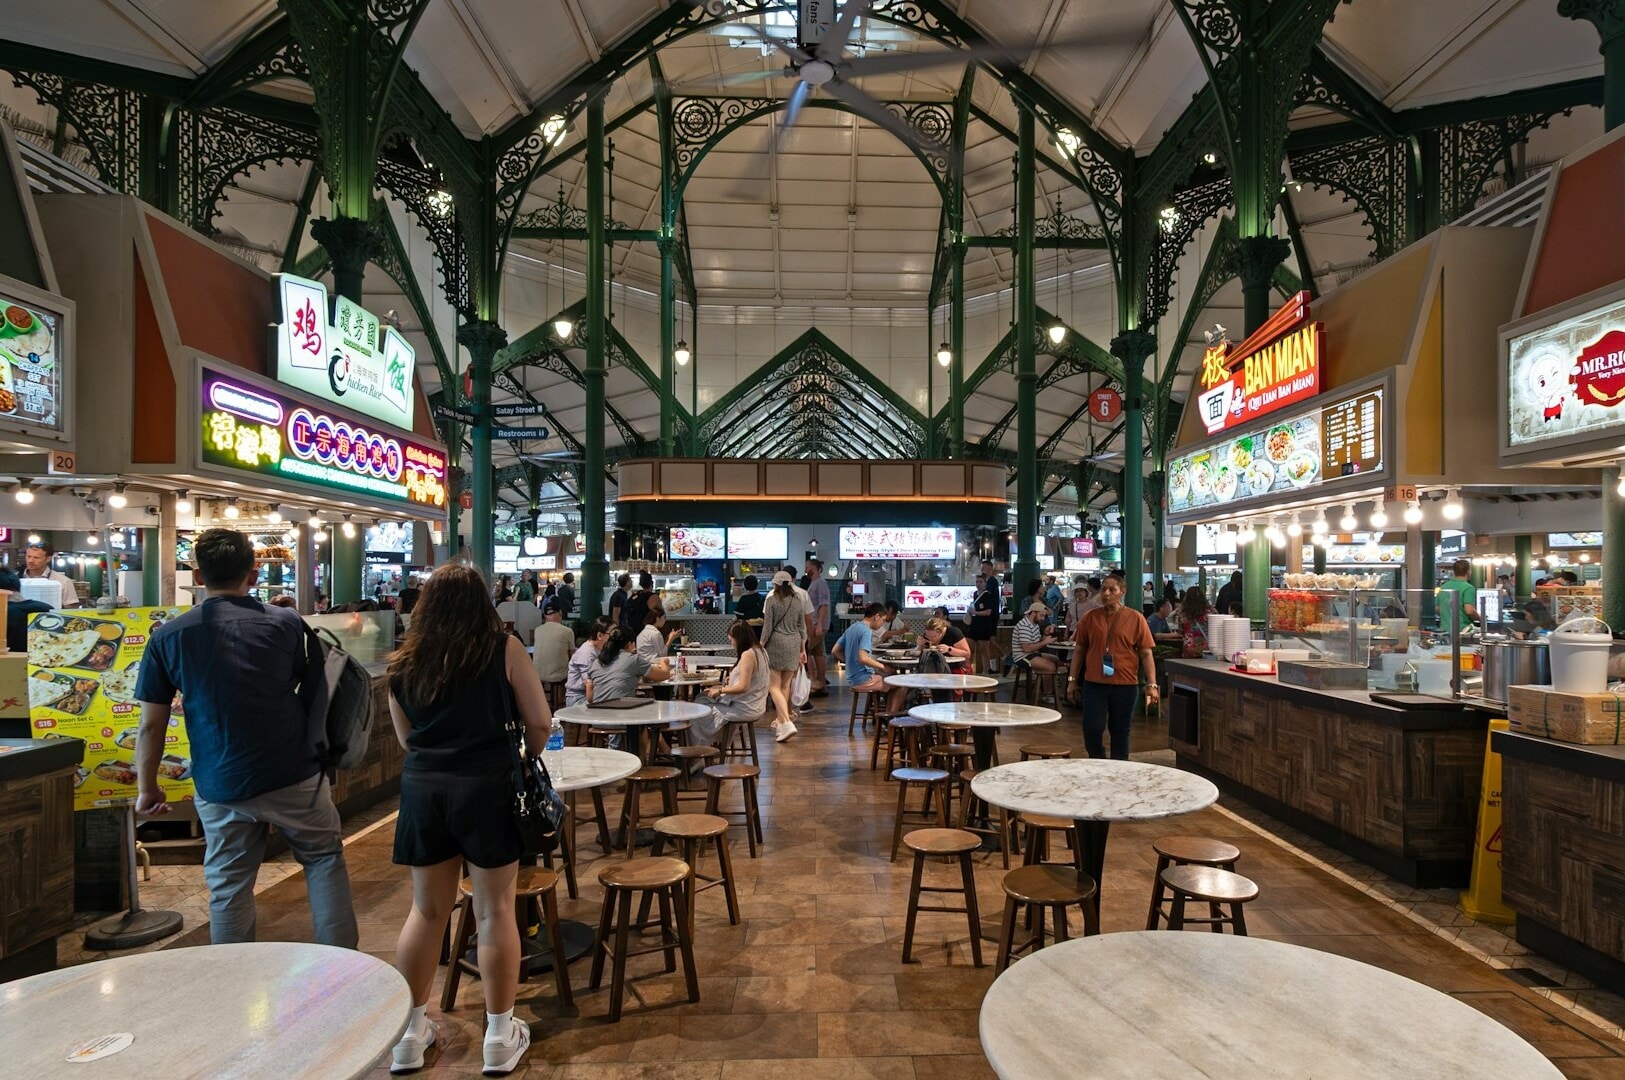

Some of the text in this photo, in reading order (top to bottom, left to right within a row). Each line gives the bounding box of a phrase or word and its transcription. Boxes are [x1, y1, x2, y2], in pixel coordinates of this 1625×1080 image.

[293, 297, 322, 356] 鸡
[1201, 342, 1230, 389] 板
[1244, 322, 1315, 397] BAN MIAN
[1597, 371, 1611, 379] Very
[369, 384, 383, 401] Rice
[1262, 388, 1278, 406] LIAN
[1277, 382, 1292, 399] BAN
[1291, 372, 1315, 394] MIAN)
[496, 406, 536, 416] Satay Street
[1101, 400, 1109, 417] 6
[1207, 391, 1225, 421] 面
[498, 430, 537, 438] Restrooms
[56, 455, 74, 470] 20
[1400, 489, 1414, 499] 16
[124, 636, 144, 644] $12.5
[38, 720, 52, 728] $15
